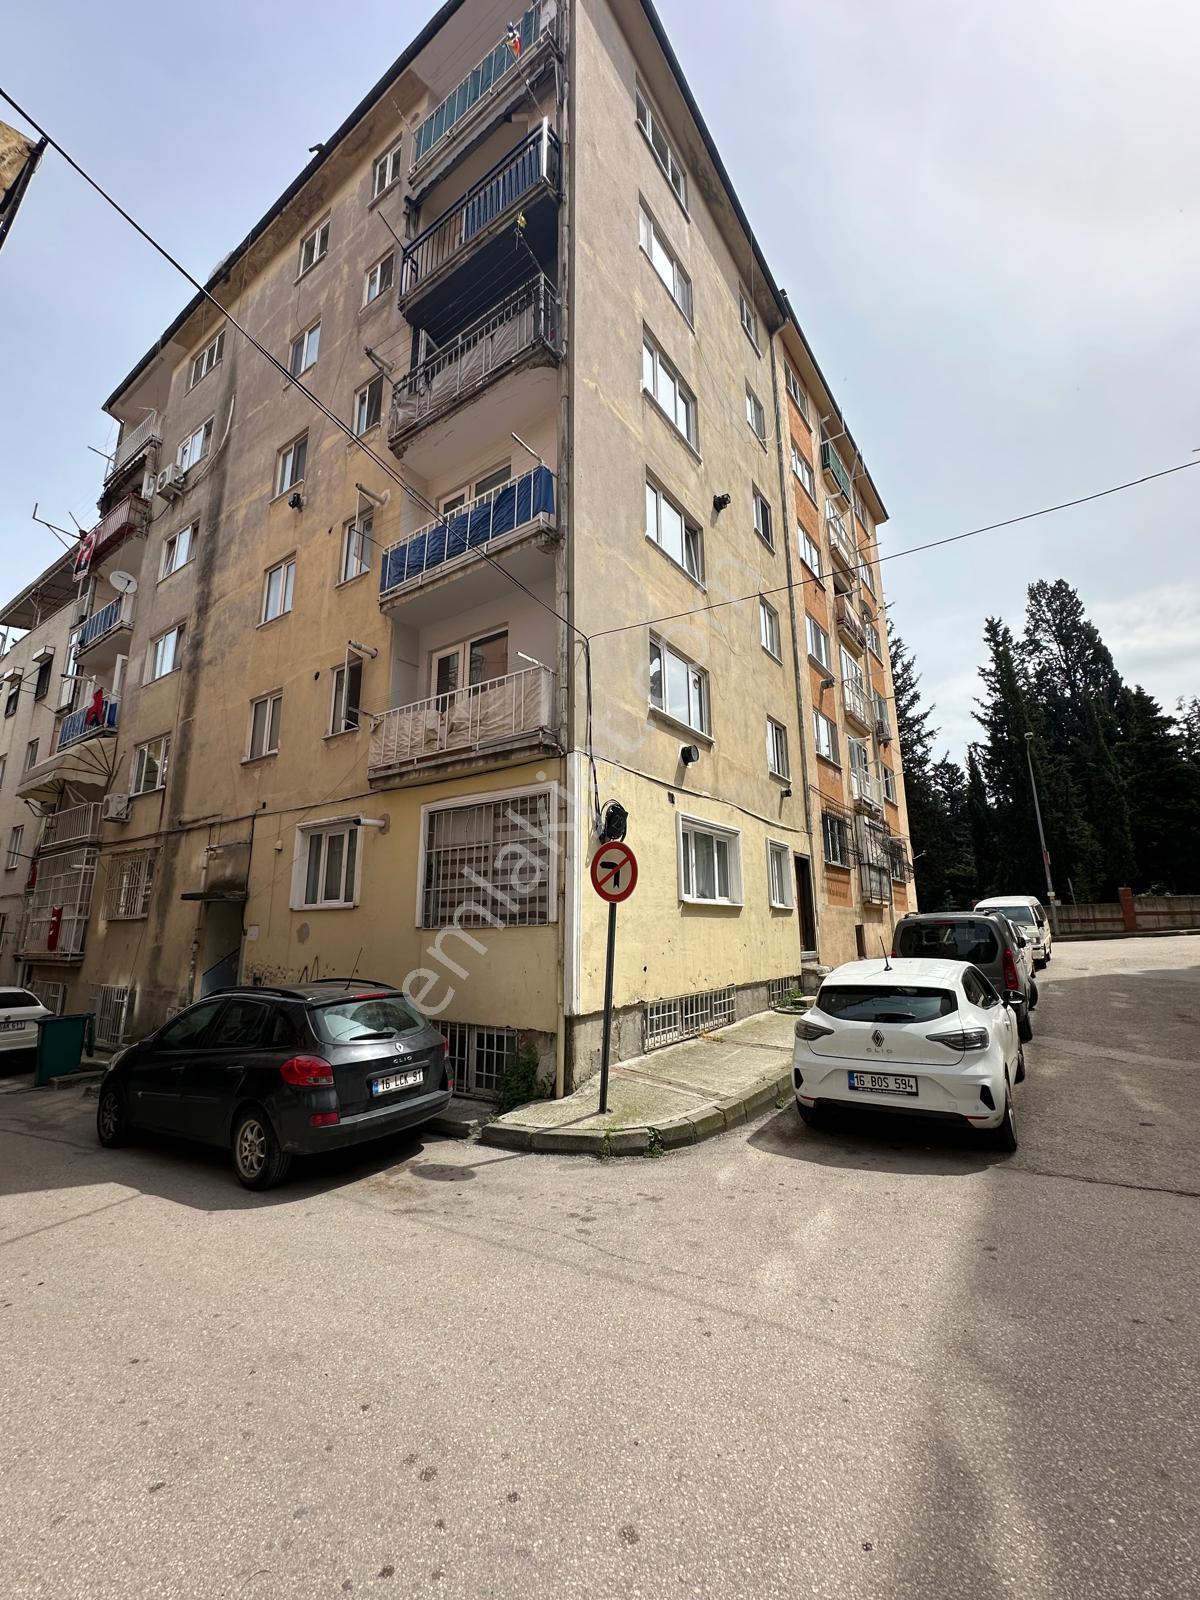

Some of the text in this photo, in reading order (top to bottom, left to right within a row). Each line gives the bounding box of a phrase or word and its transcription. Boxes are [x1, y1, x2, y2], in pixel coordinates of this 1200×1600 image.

[393, 1055, 413, 1064] CLIO
[381, 1078, 390, 1090] 16
[394, 1073, 409, 1087] LCK
[855, 1074, 913, 1090] 16 BOS 594
